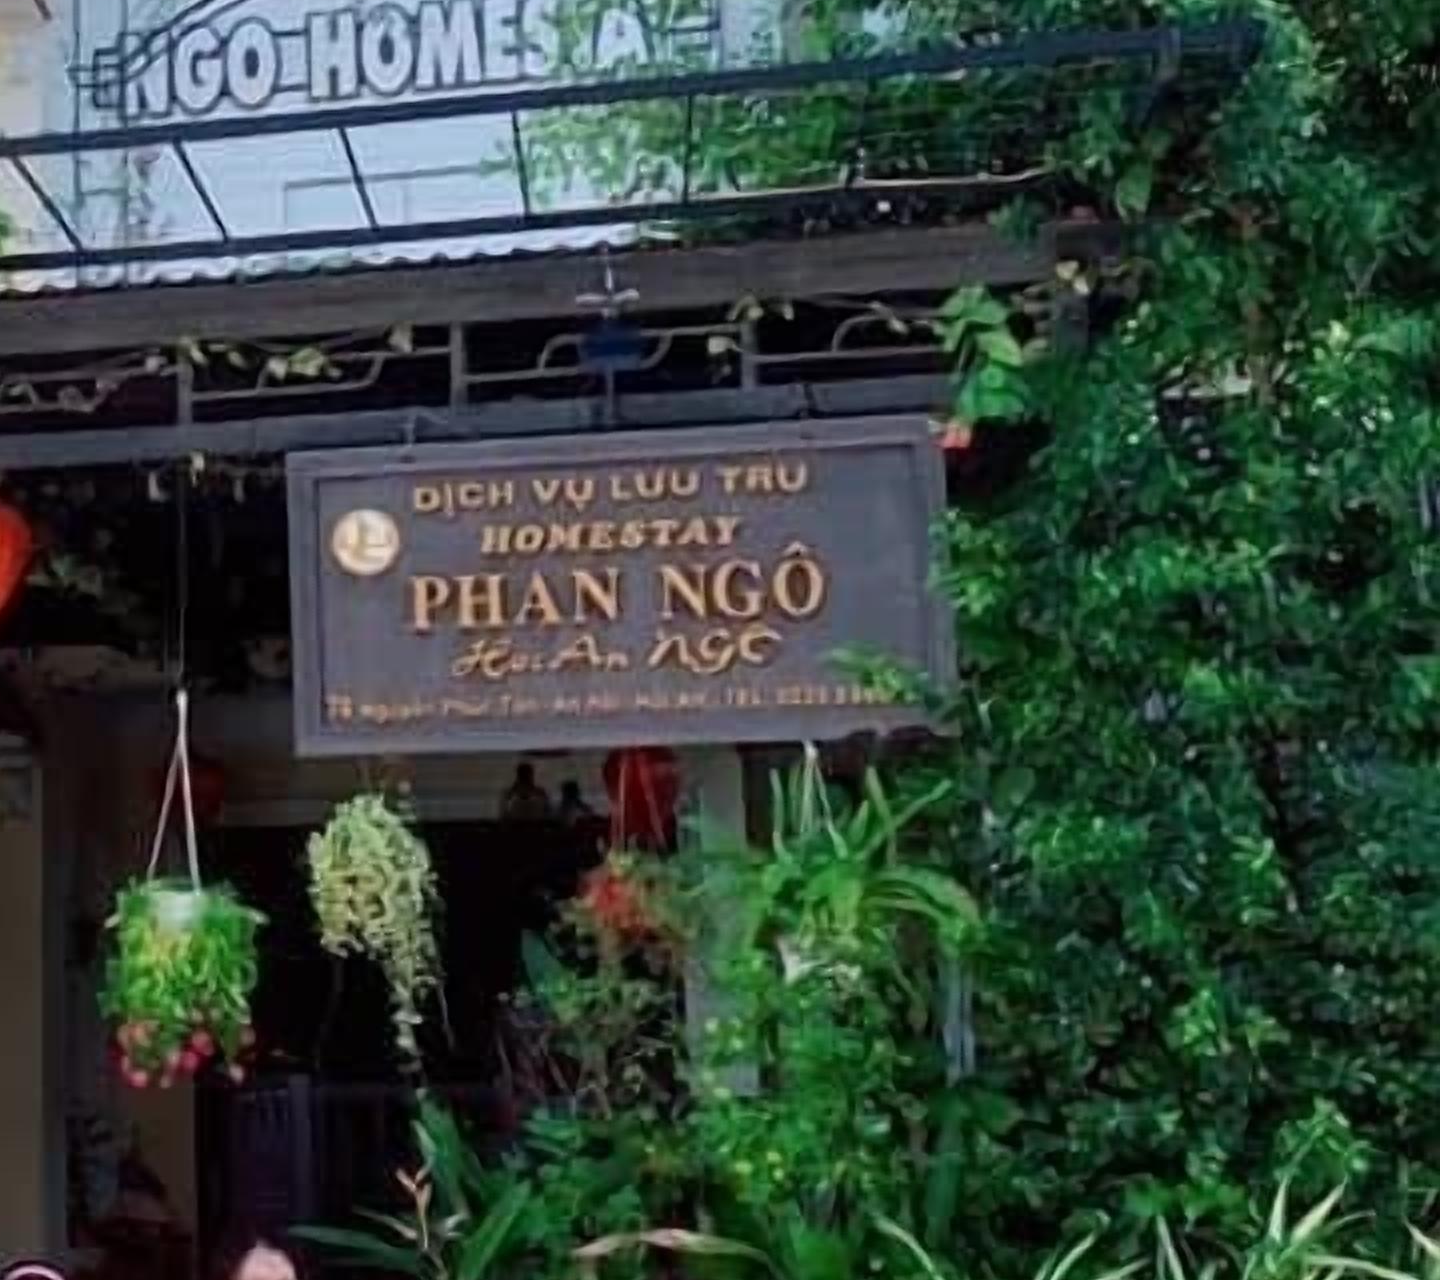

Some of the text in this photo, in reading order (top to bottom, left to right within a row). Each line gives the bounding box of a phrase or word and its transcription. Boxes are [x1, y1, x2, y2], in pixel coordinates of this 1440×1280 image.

[413, 480, 514, 517] DỊCH
[479, 516, 742, 555] HOMESTAY
[411, 541, 825, 631] PHAN NGÔ
